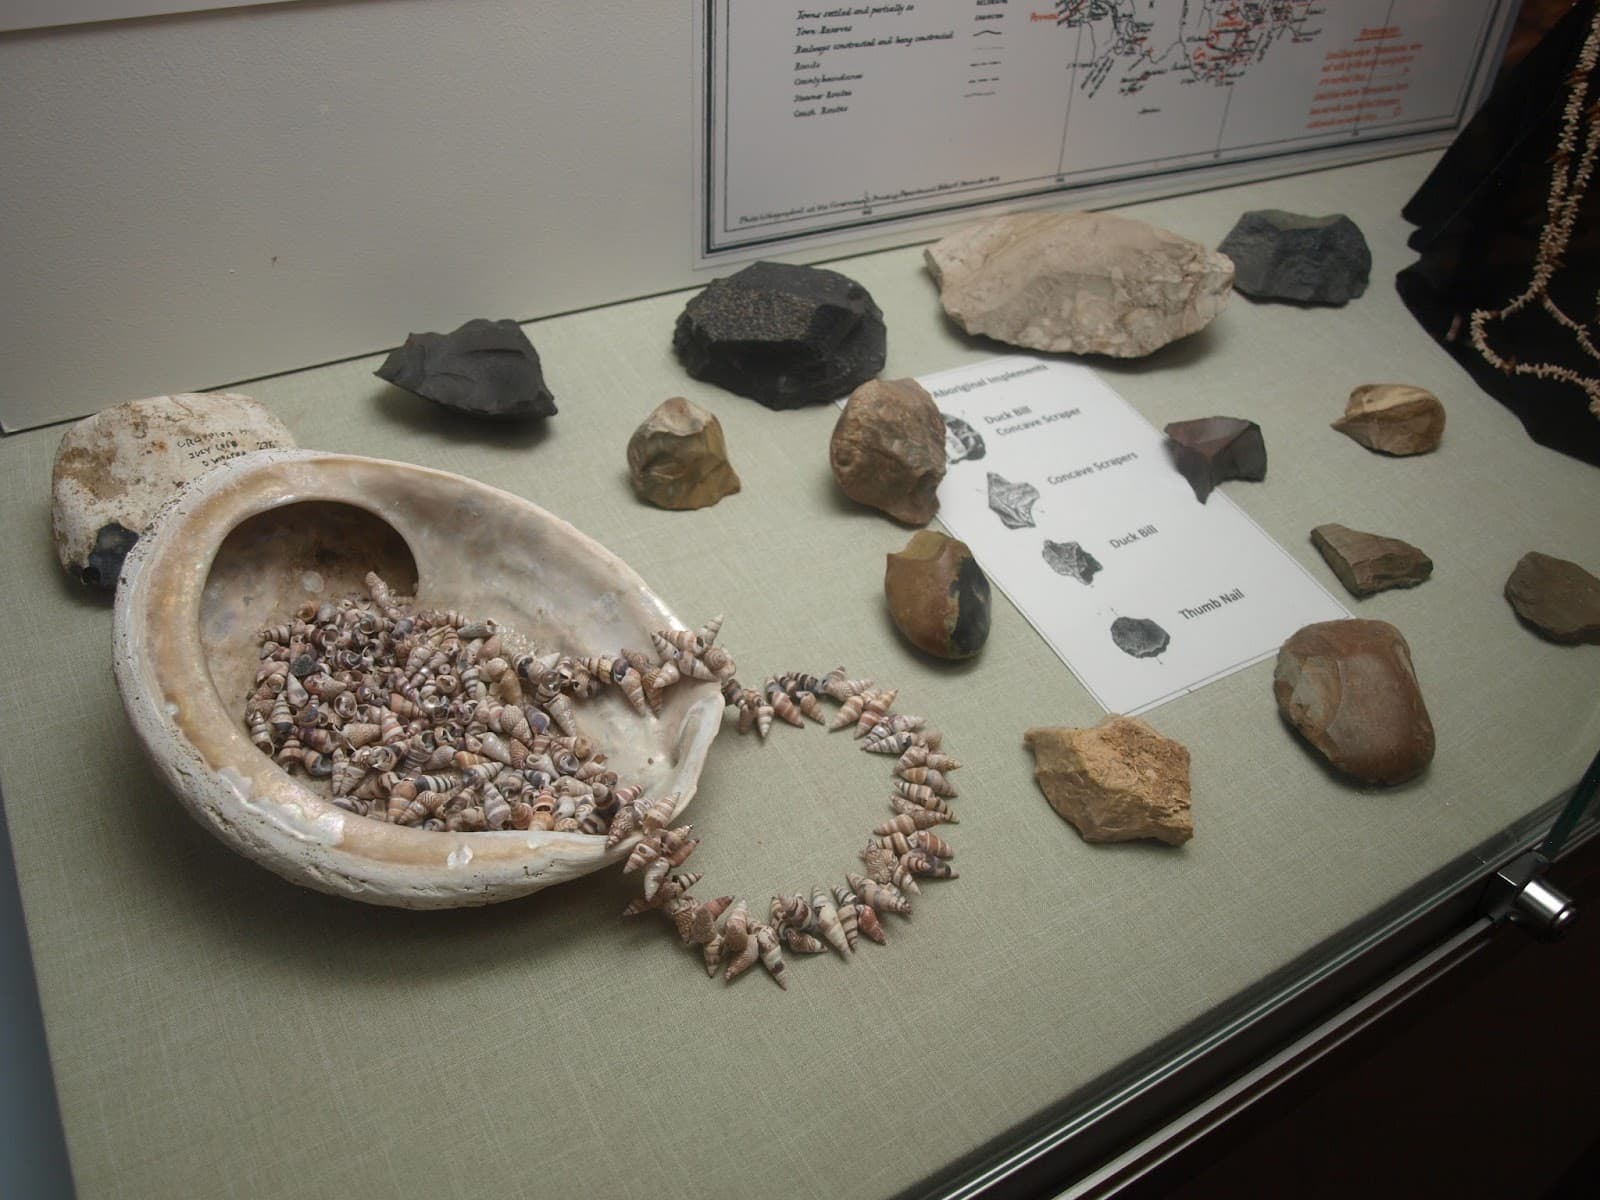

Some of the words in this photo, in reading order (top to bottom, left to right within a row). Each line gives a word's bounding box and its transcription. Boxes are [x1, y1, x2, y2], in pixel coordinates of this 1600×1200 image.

[853, 6, 869, 16] and
[933, 378, 987, 398] Aboriginal
[987, 363, 1048, 385] Implements
[984, 410, 1012, 425] Duck
[1013, 405, 1032, 418] Bill
[996, 419, 1040, 436] Concave
[1041, 406, 1081, 428] Scraper
[1047, 466, 1093, 486] Concave
[1093, 450, 1139, 474] Scrapers
[1109, 532, 1137, 550] Duck
[1138, 524, 1158, 539] Bill
[1178, 598, 1222, 621] Thumb
[1222, 588, 1245, 607] Nail
